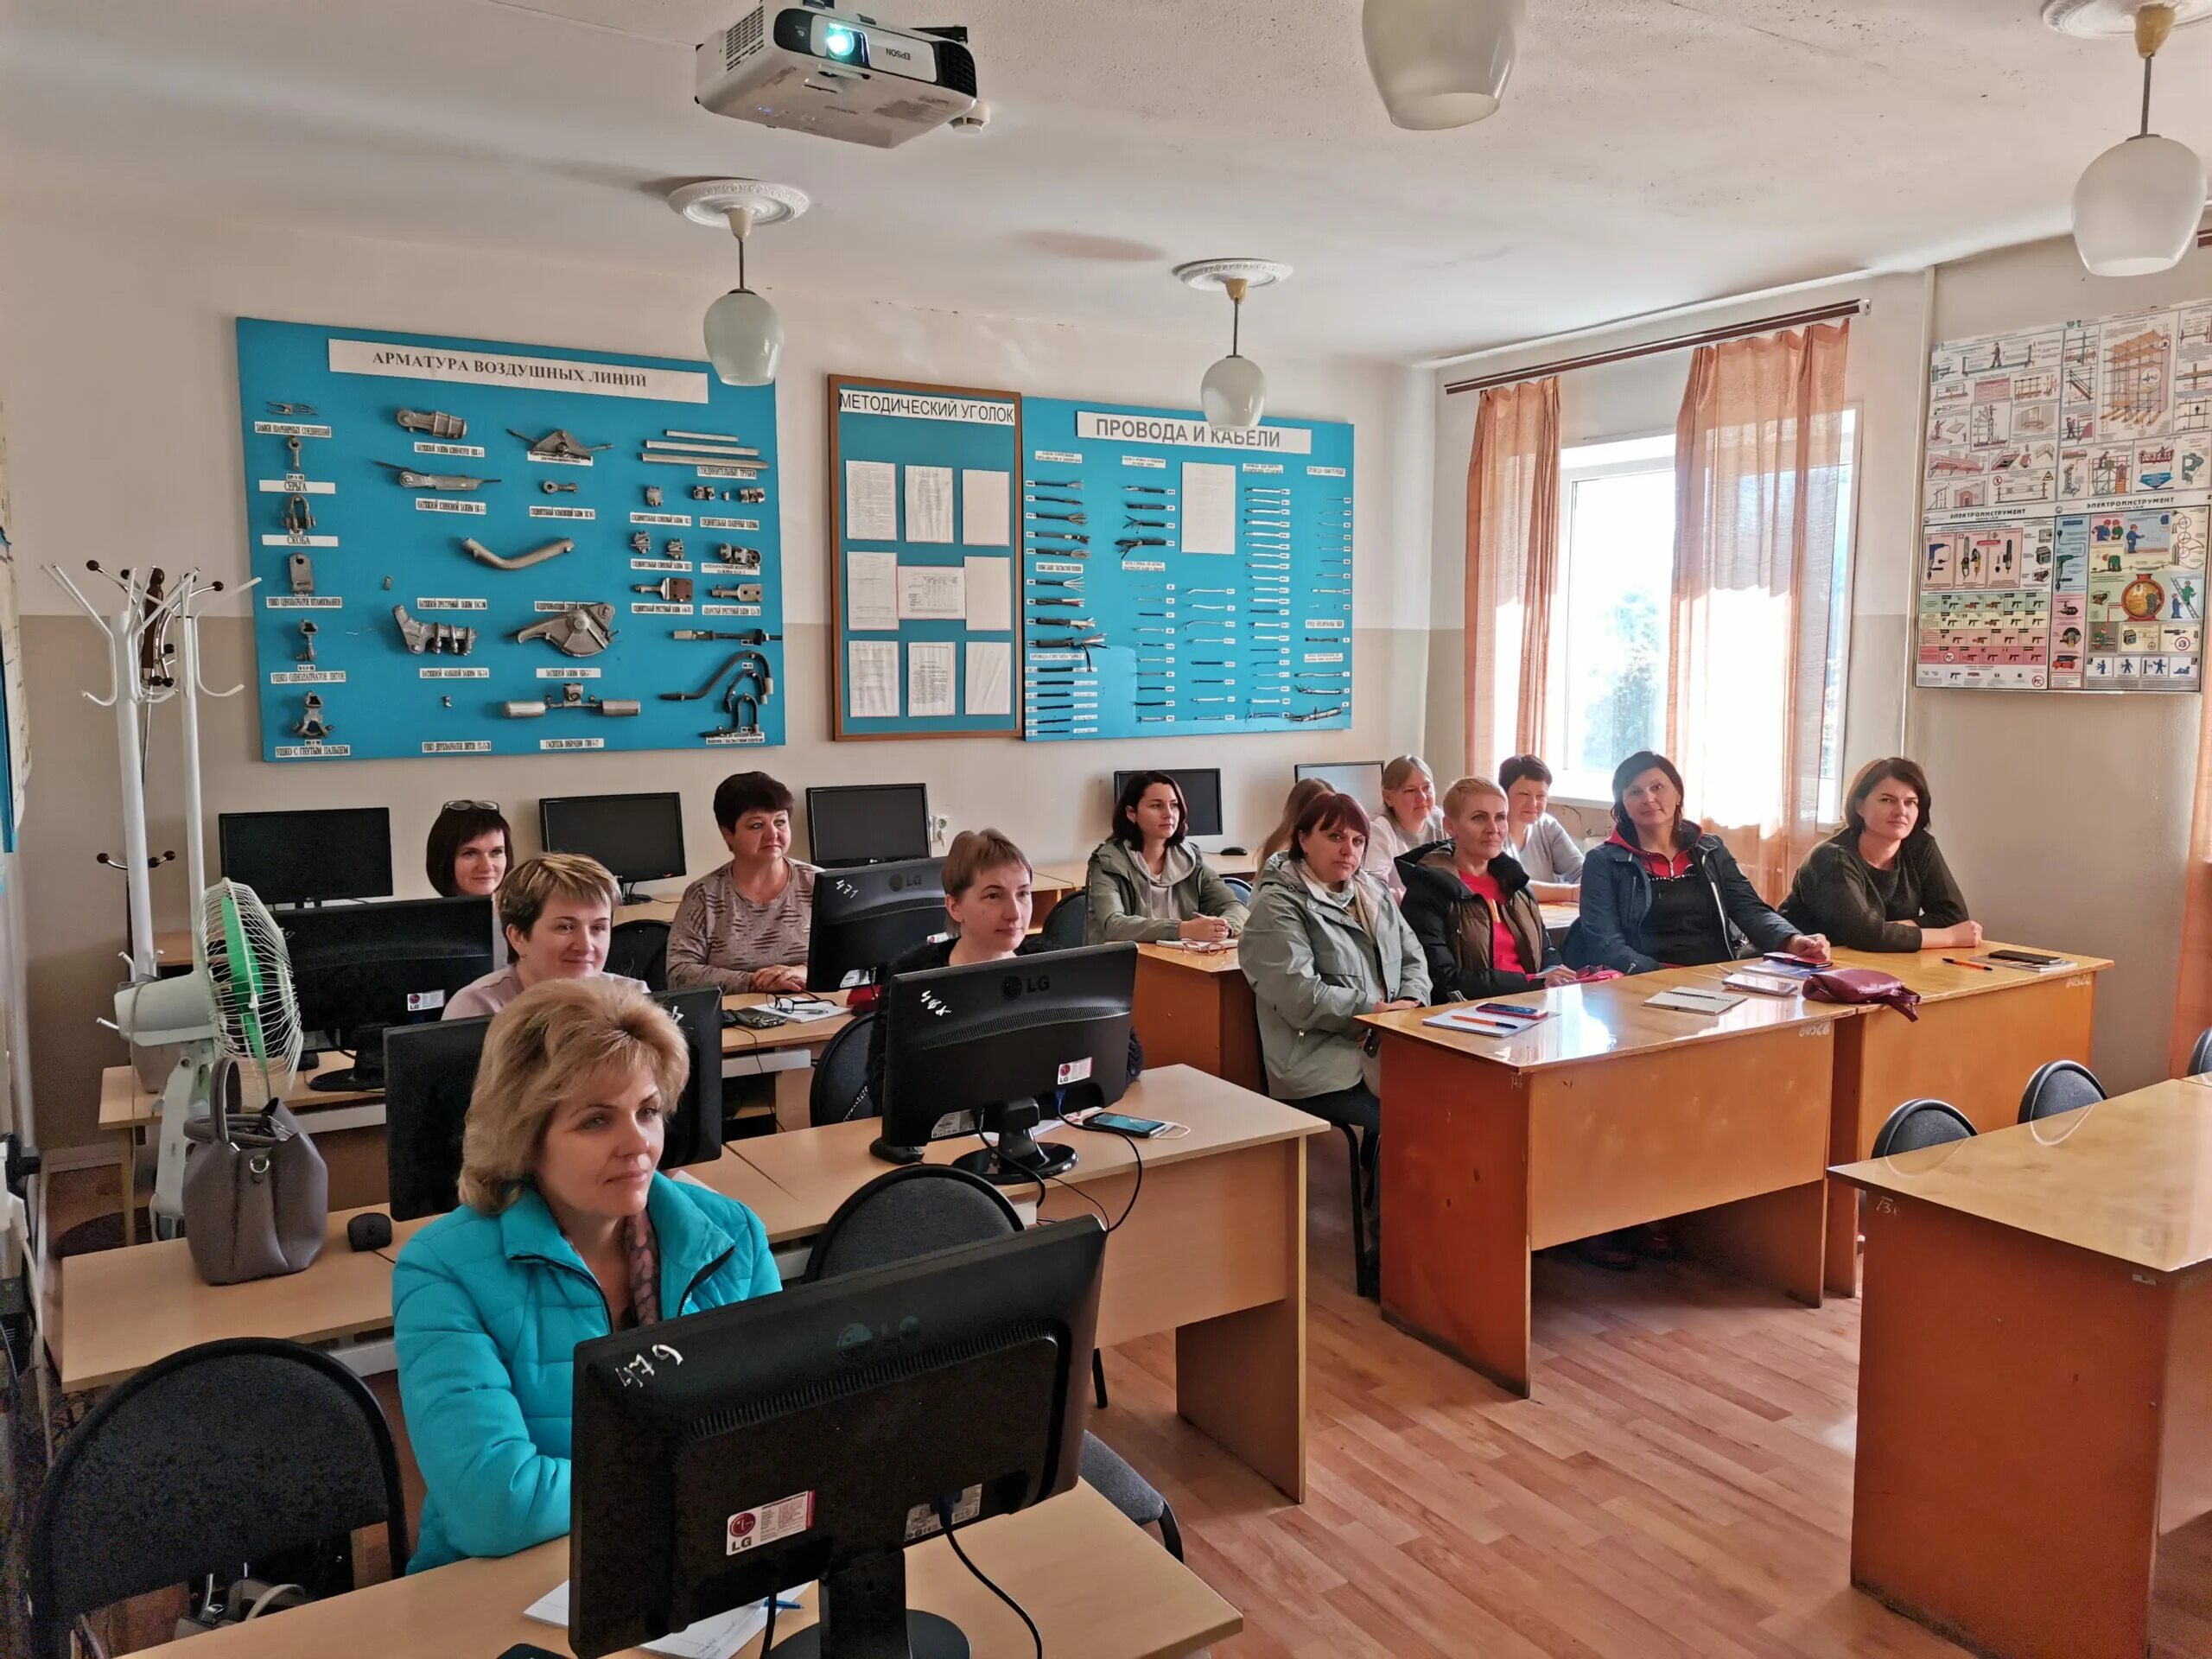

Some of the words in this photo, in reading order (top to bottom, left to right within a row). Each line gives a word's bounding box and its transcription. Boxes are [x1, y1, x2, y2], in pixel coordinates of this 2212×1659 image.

[886, 48, 911, 60] EPSON
[372, 352, 469, 372] АРМАТУРА
[474, 359, 585, 383] ВОЗДУШНЫХ
[589, 371, 647, 388] ЛИНИЙ
[840, 393, 957, 417] МЕТОДИЧЕСКИЙ
[961, 404, 1014, 423] УГОЛОК
[1096, 418, 1188, 443] ПРОВОДА
[1193, 425, 1205, 442] И
[284, 482, 308, 492] СЕРЬГА
[287, 536, 311, 545] СКОБА
[836, 880, 859, 899] 471
[1027, 976, 1050, 993] LG
[732, 1536, 752, 1552] LG
